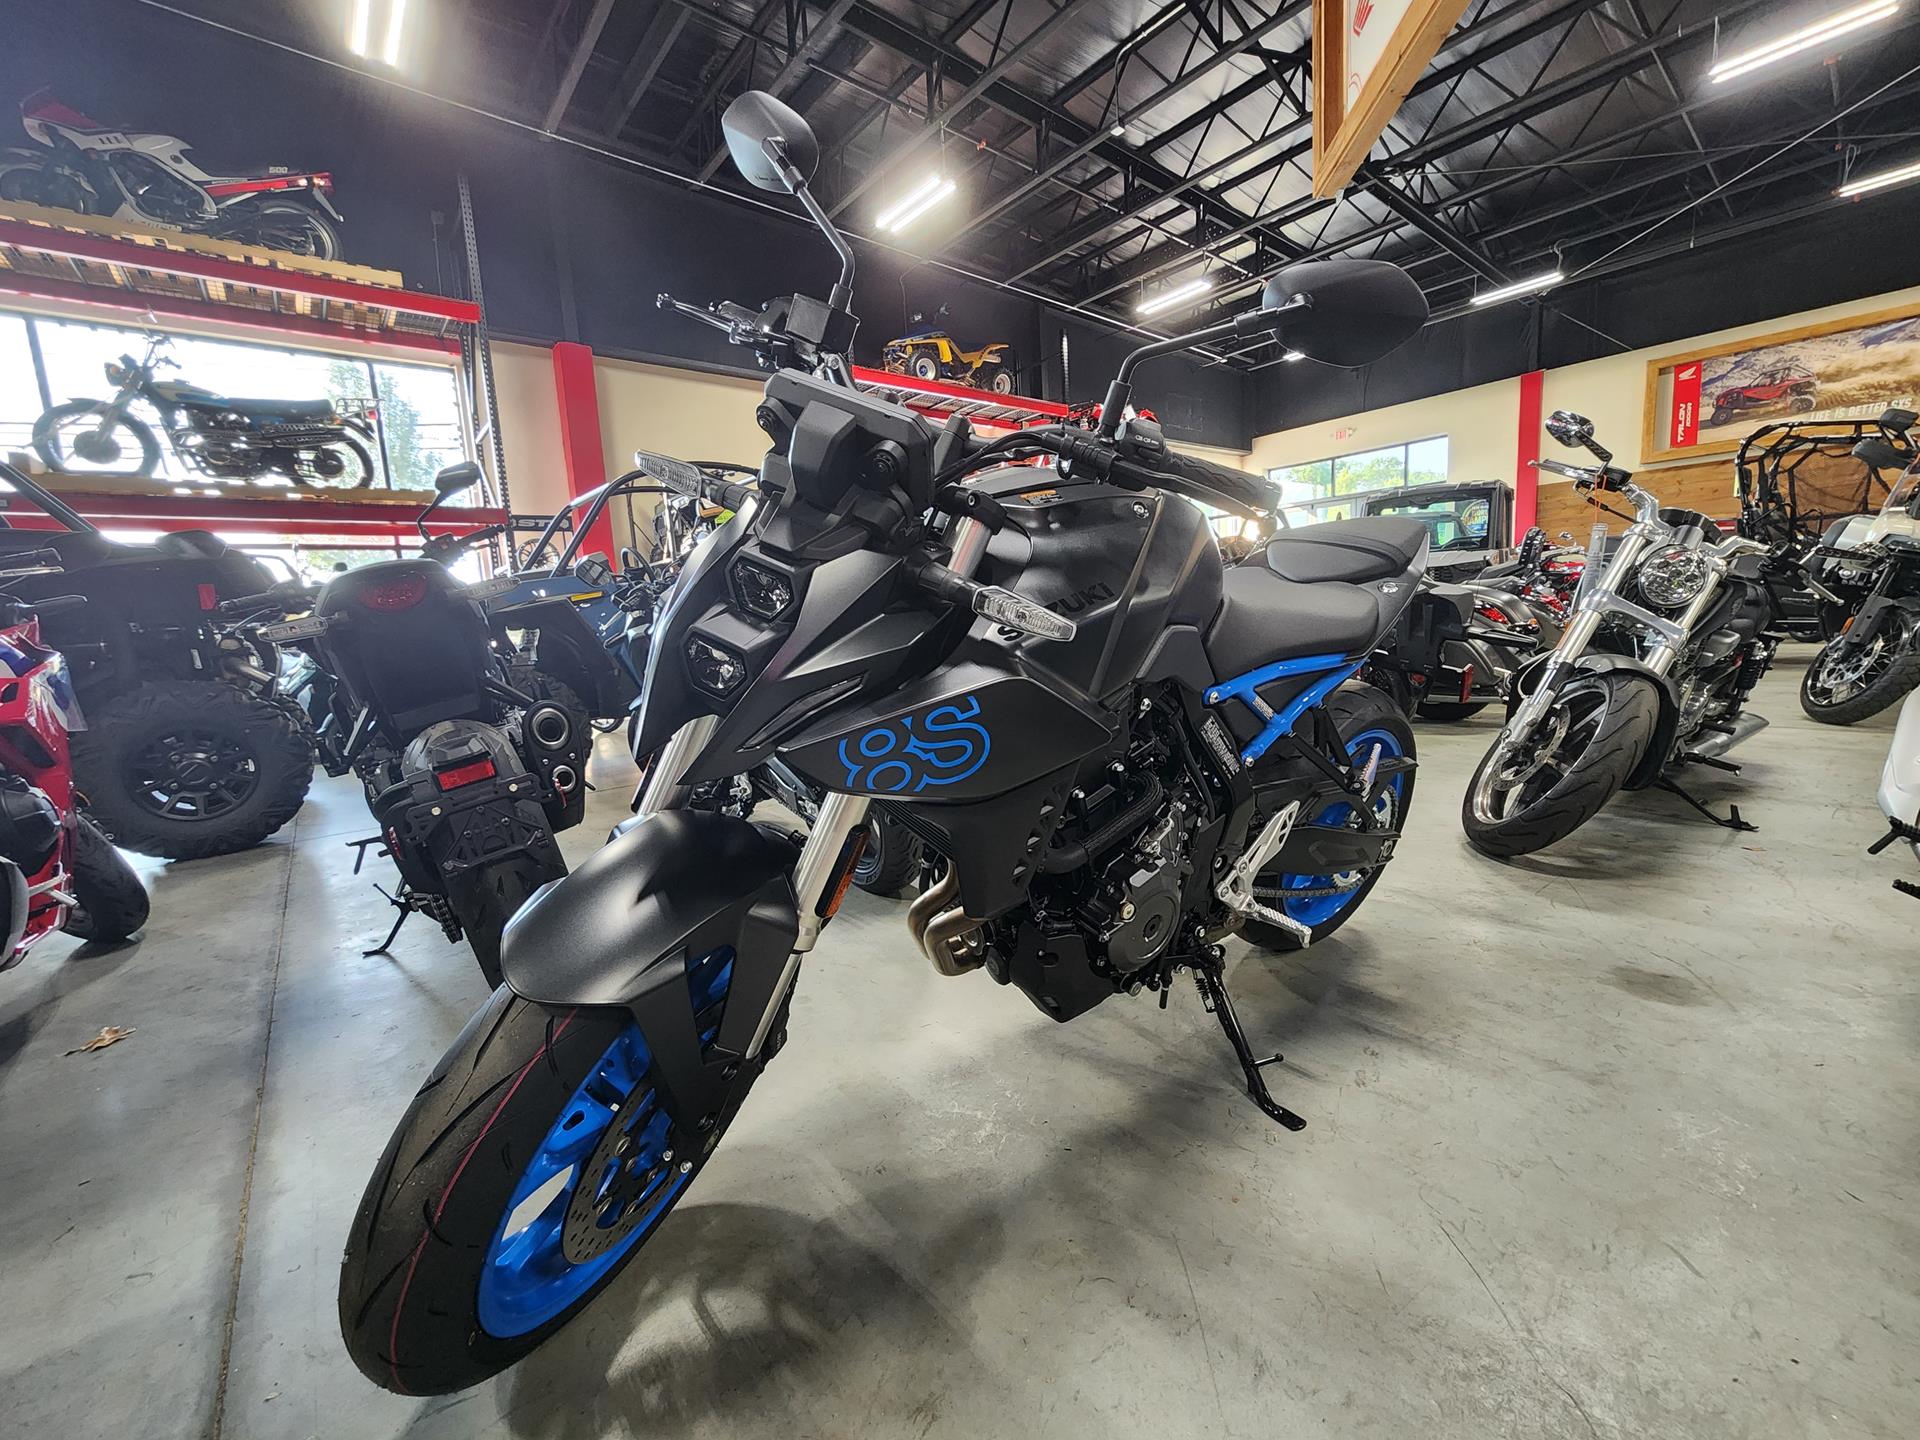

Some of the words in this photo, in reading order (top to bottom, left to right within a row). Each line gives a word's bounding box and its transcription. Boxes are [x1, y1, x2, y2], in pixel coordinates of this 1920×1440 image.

[268, 166, 288, 174] 500
[1810, 410, 1832, 421] LIFE
[1835, 406, 1846, 418] IS
[1848, 401, 1888, 417] BETTER
[1677, 403, 1686, 443] TALON
